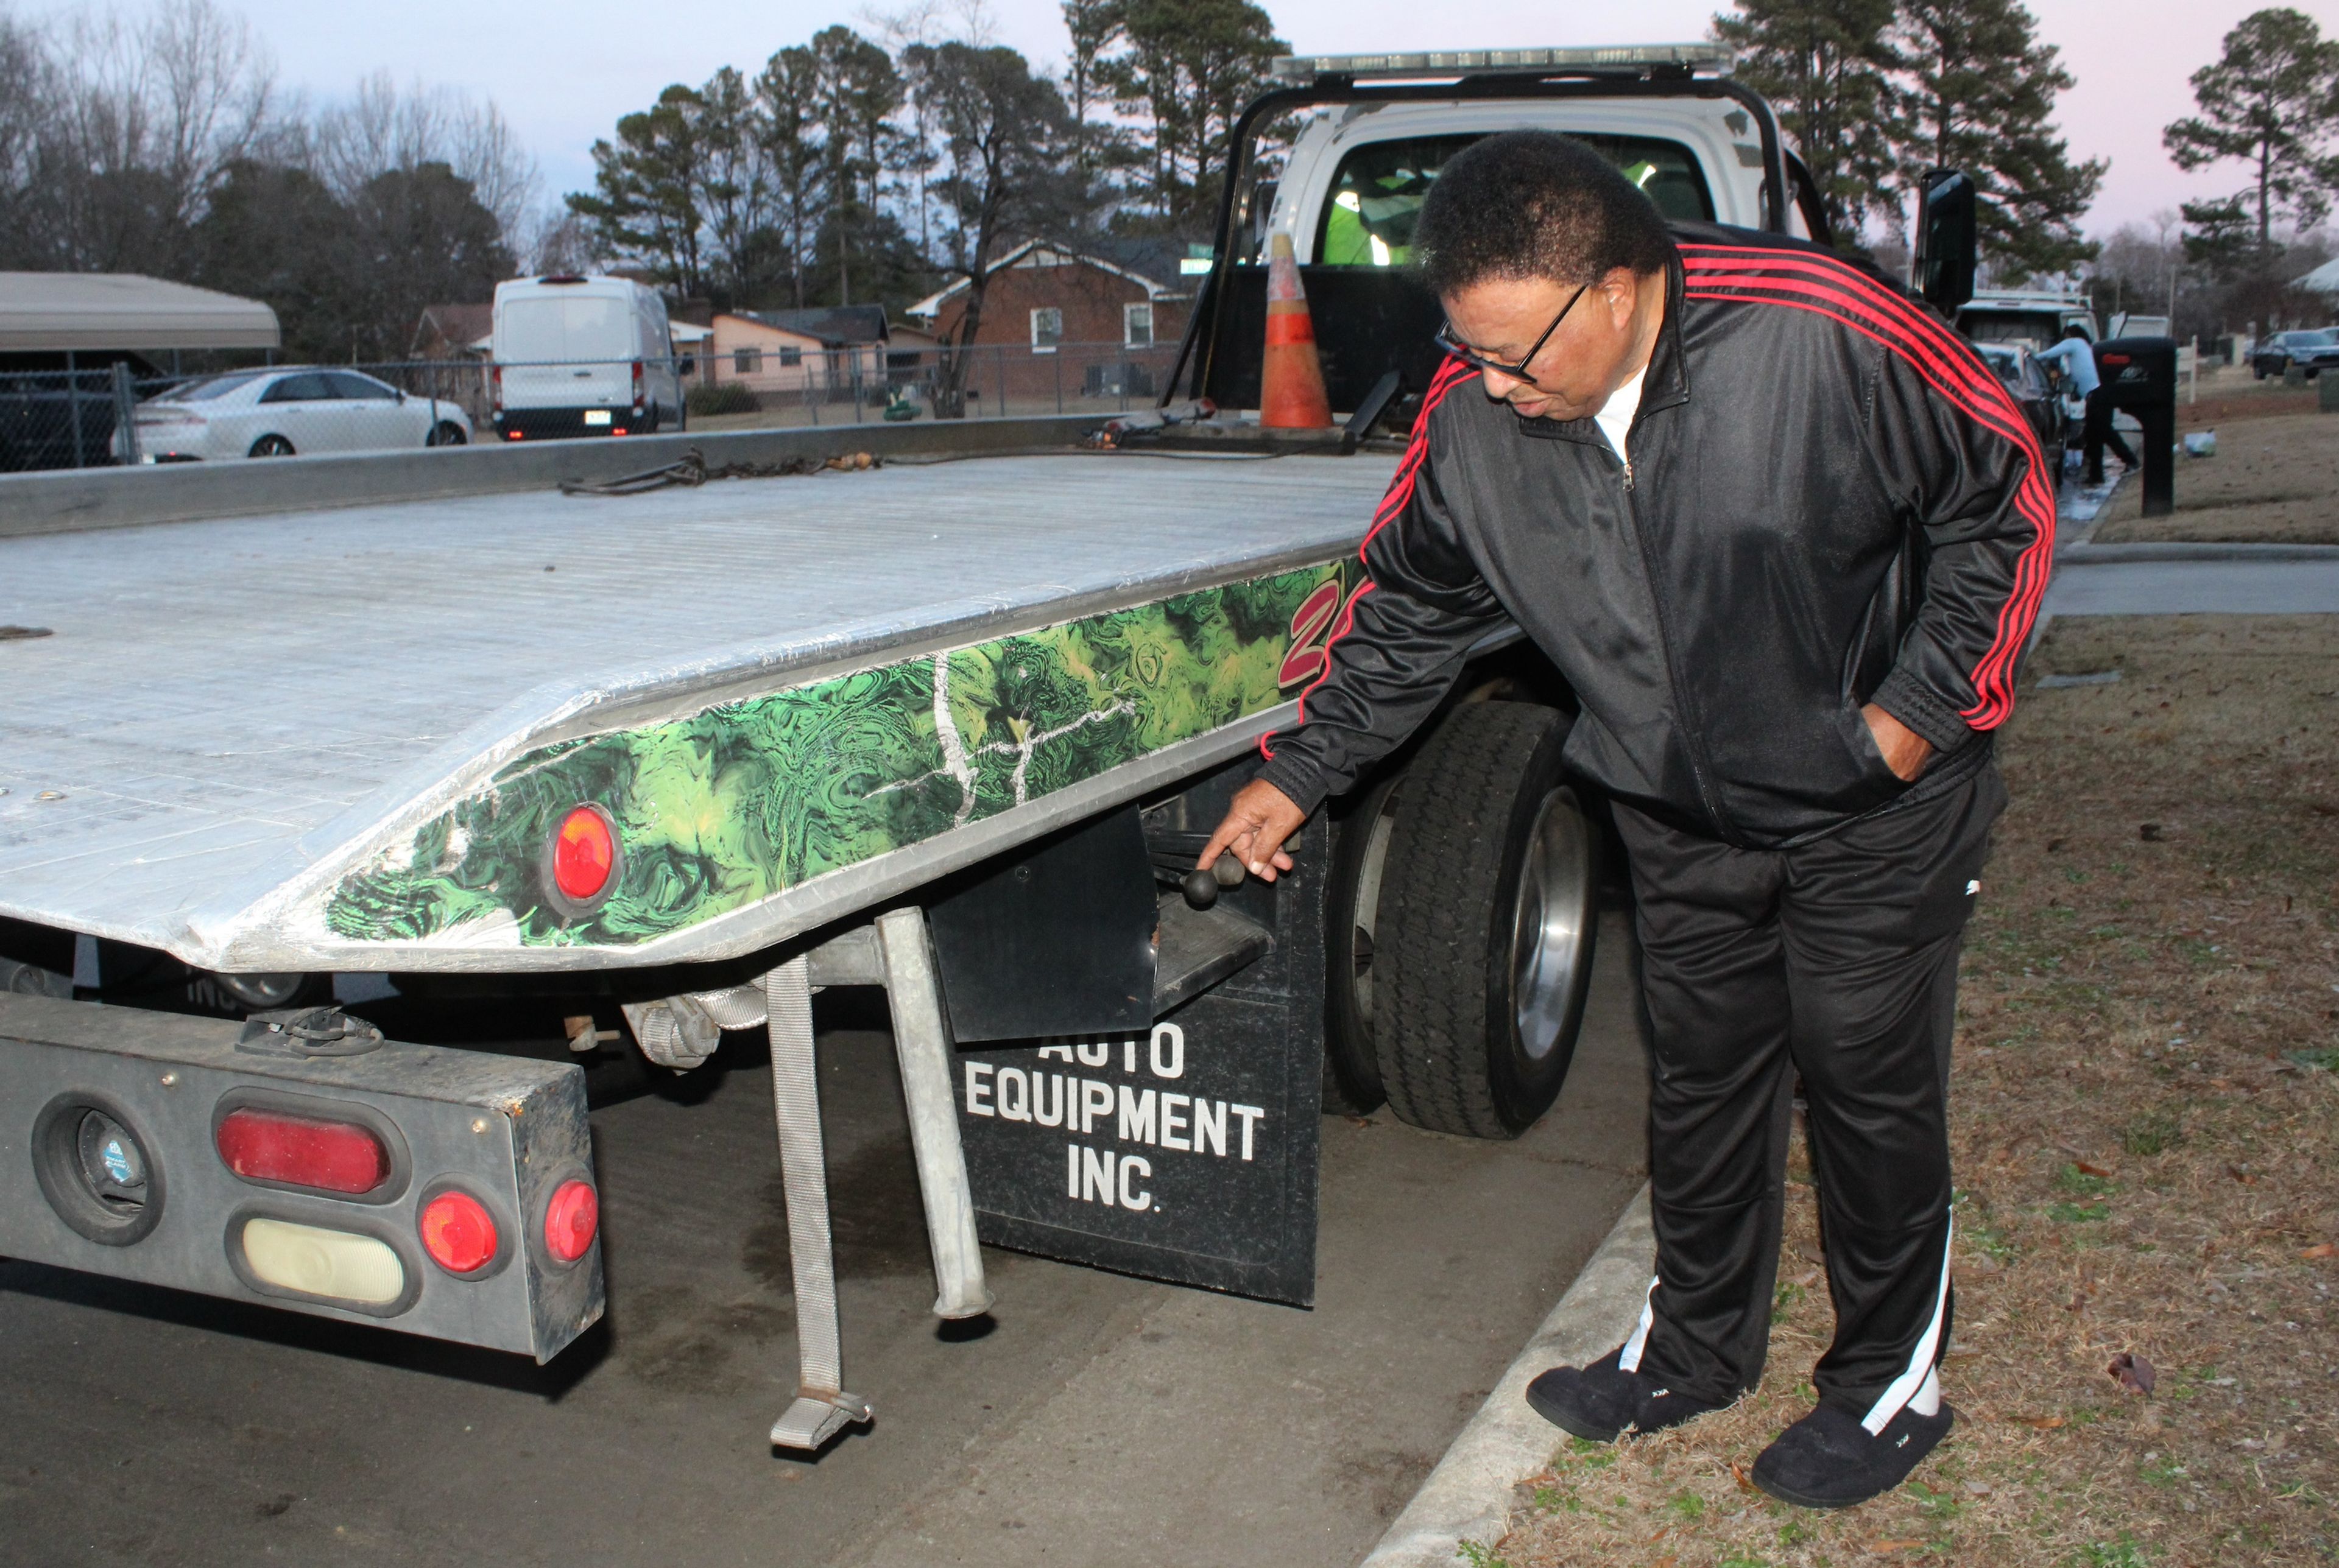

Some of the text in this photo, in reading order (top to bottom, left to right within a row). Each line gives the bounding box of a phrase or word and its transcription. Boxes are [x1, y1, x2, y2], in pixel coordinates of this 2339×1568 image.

[1278, 575, 1369, 689] 2
[965, 1061, 1265, 1161] EQUIPMENT
[1068, 1144, 1160, 1212] INC.
